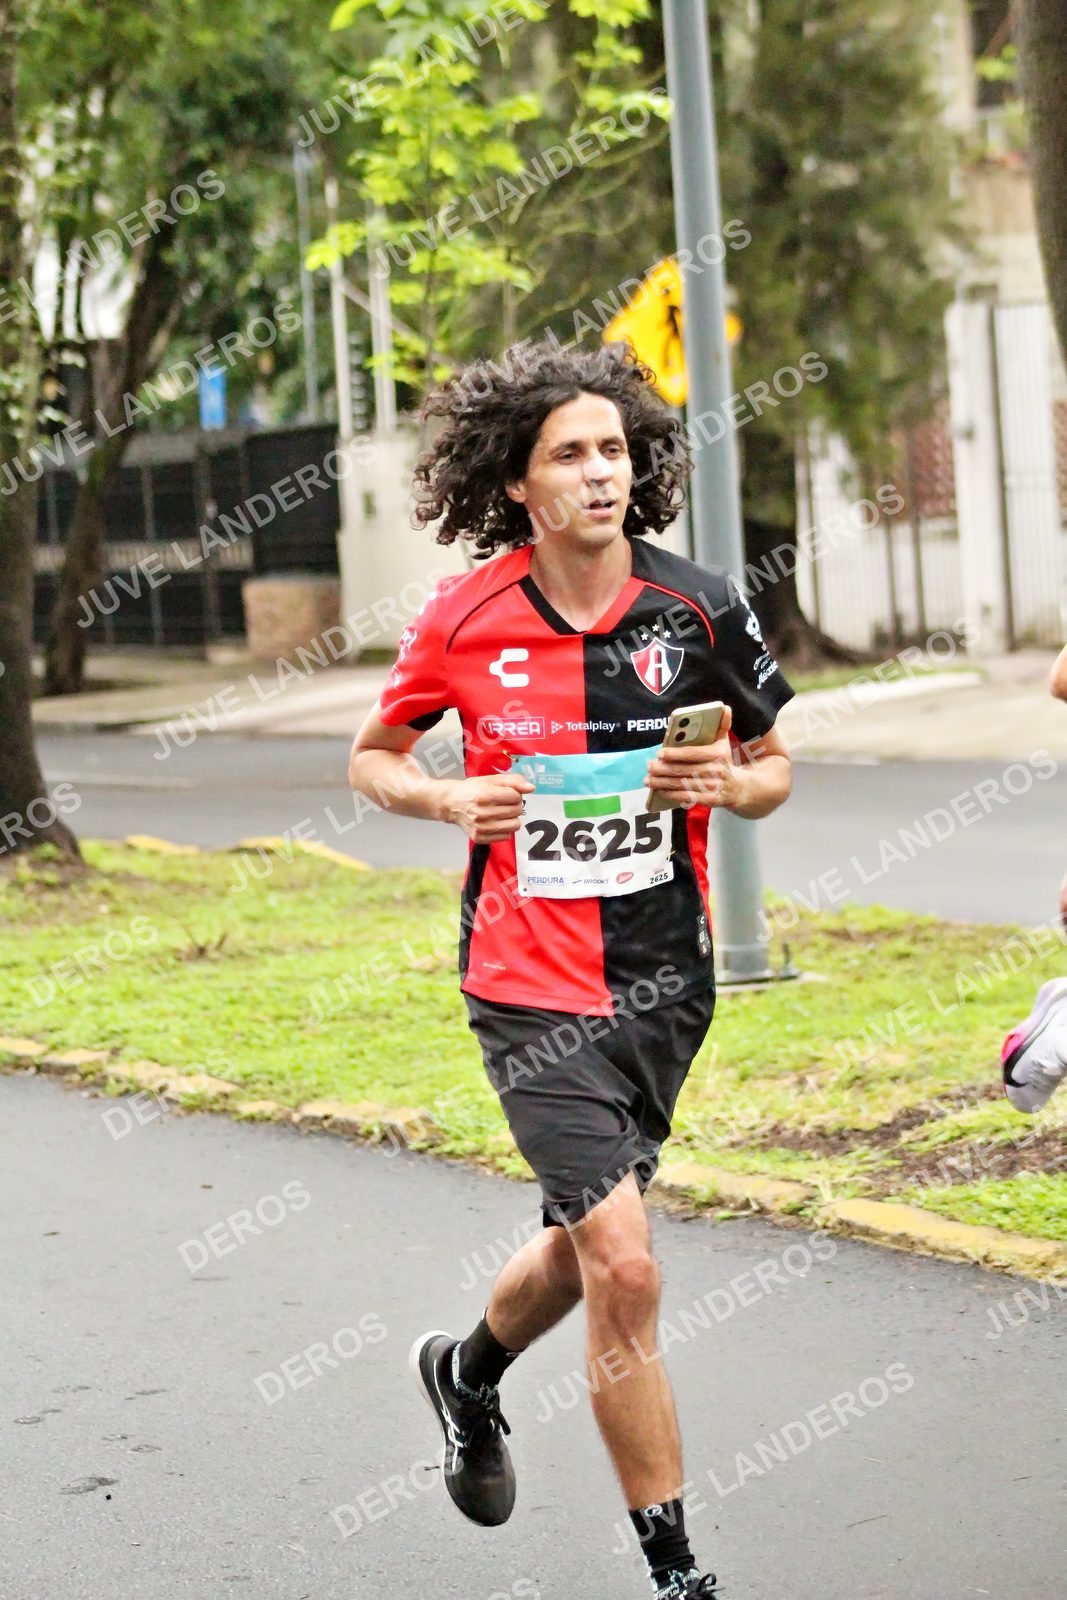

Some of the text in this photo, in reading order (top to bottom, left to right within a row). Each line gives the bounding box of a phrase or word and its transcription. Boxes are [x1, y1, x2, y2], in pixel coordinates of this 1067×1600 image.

[525, 812, 663, 862] 2625
[527, 876, 565, 884] PERDURA
[649, 872, 669, 885] 2625
